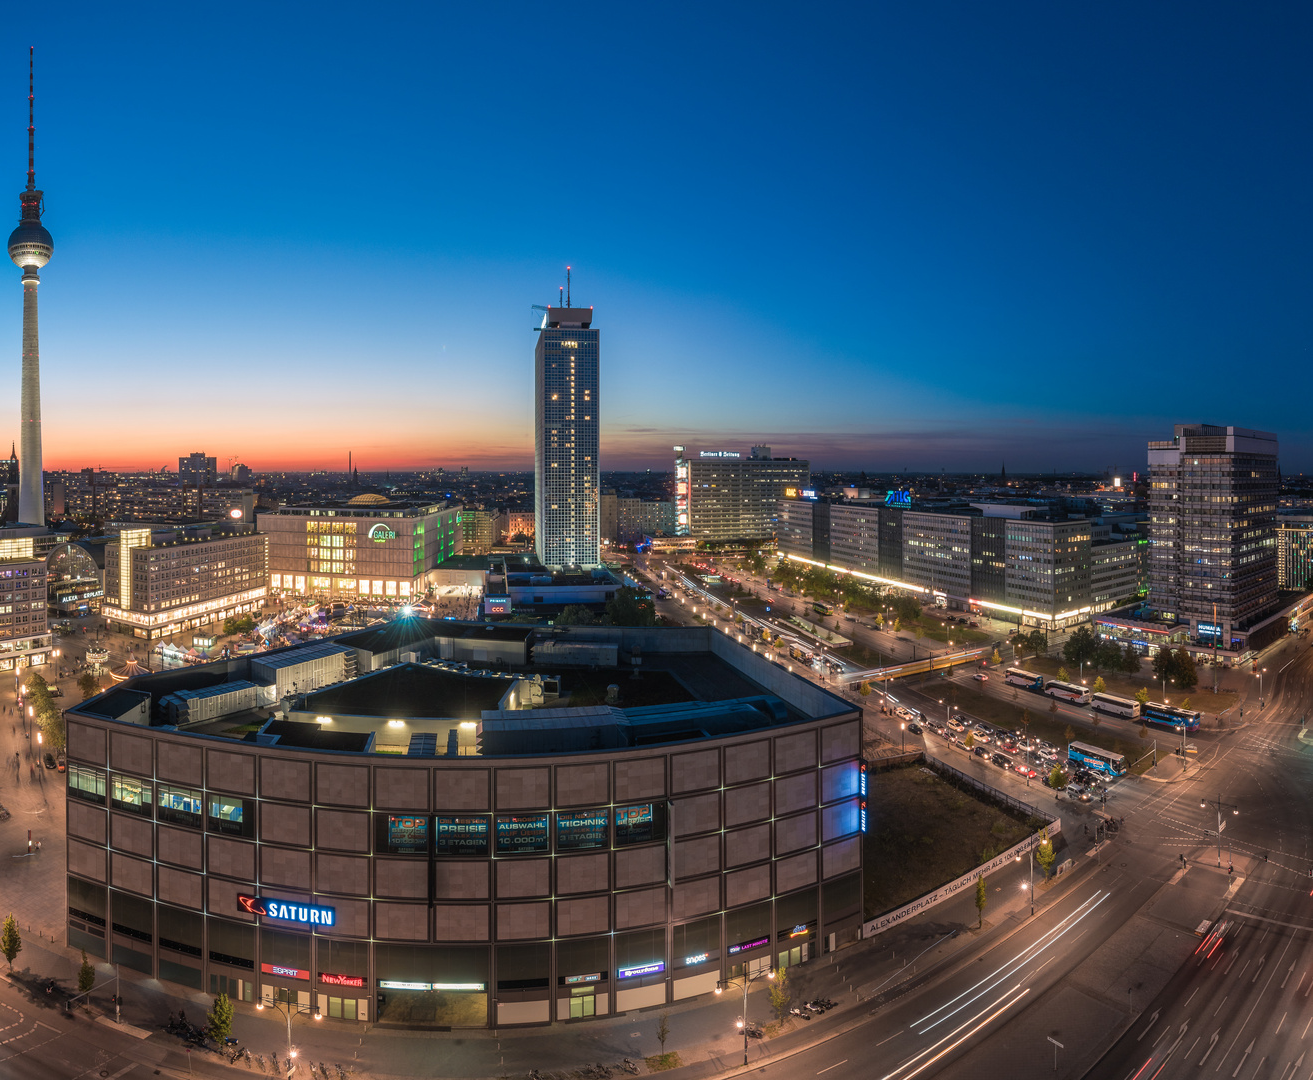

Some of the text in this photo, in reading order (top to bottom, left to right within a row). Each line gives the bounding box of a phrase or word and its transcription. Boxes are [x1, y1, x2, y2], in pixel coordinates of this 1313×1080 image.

[618, 807, 649, 819] TOP
[393, 818, 426, 828] TOP
[499, 822, 545, 830] AUSWAHL
[560, 819, 605, 827] TECHNIK
[870, 894, 938, 932] ALEXANDERPLATZ
[944, 876, 972, 896] TÄGLICH
[972, 865, 991, 880] MEHR
[991, 860, 1003, 869] ALS
[269, 903, 332, 924] SATURN
[793, 925, 806, 933] dm
[273, 966, 298, 977] ESPRIT
